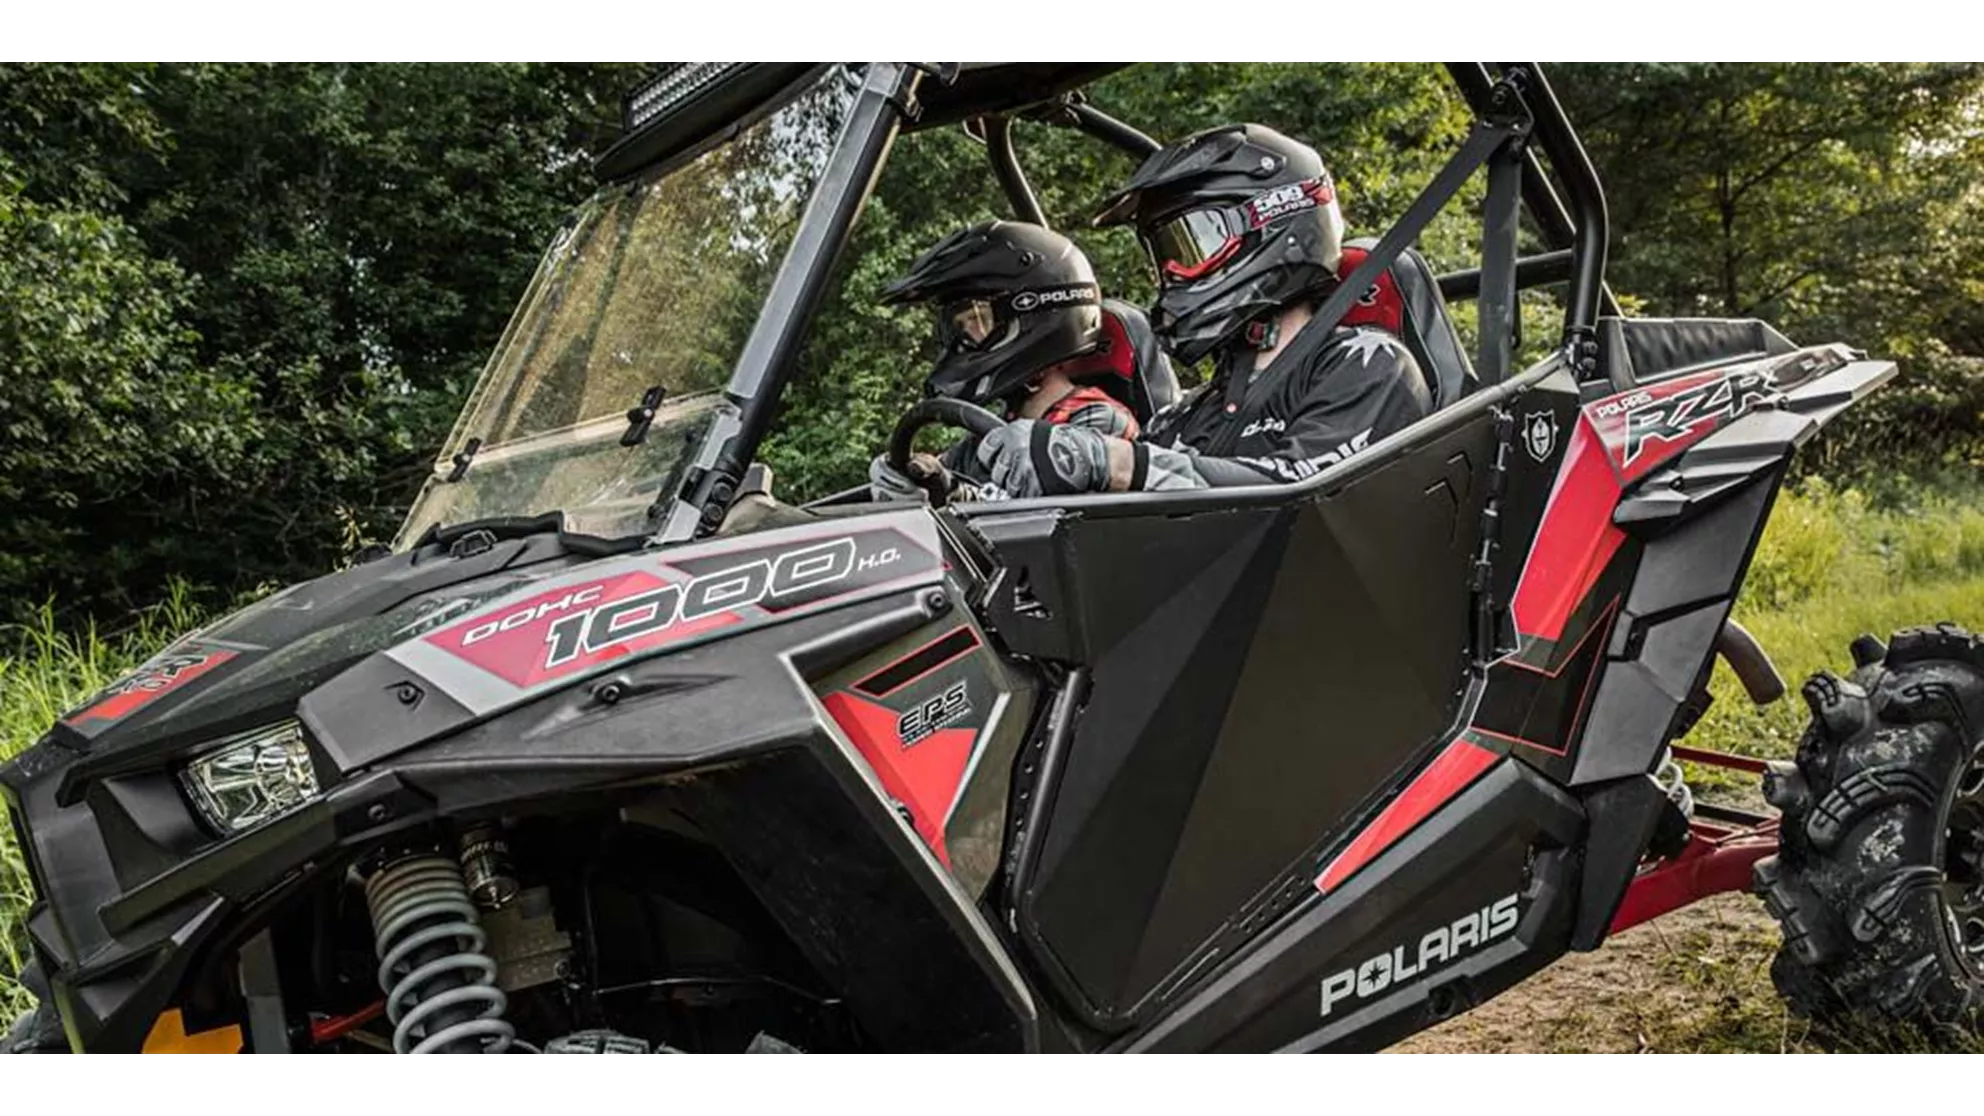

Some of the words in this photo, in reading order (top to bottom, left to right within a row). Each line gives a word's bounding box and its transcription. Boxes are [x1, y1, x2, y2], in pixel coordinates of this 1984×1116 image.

[1596, 391, 1654, 419] POLARIS
[461, 584, 604, 647] DOHC
[543, 537, 857, 671] 1000
[896, 680, 968, 737] EPS
[1319, 893, 1520, 1017] POLARIS
